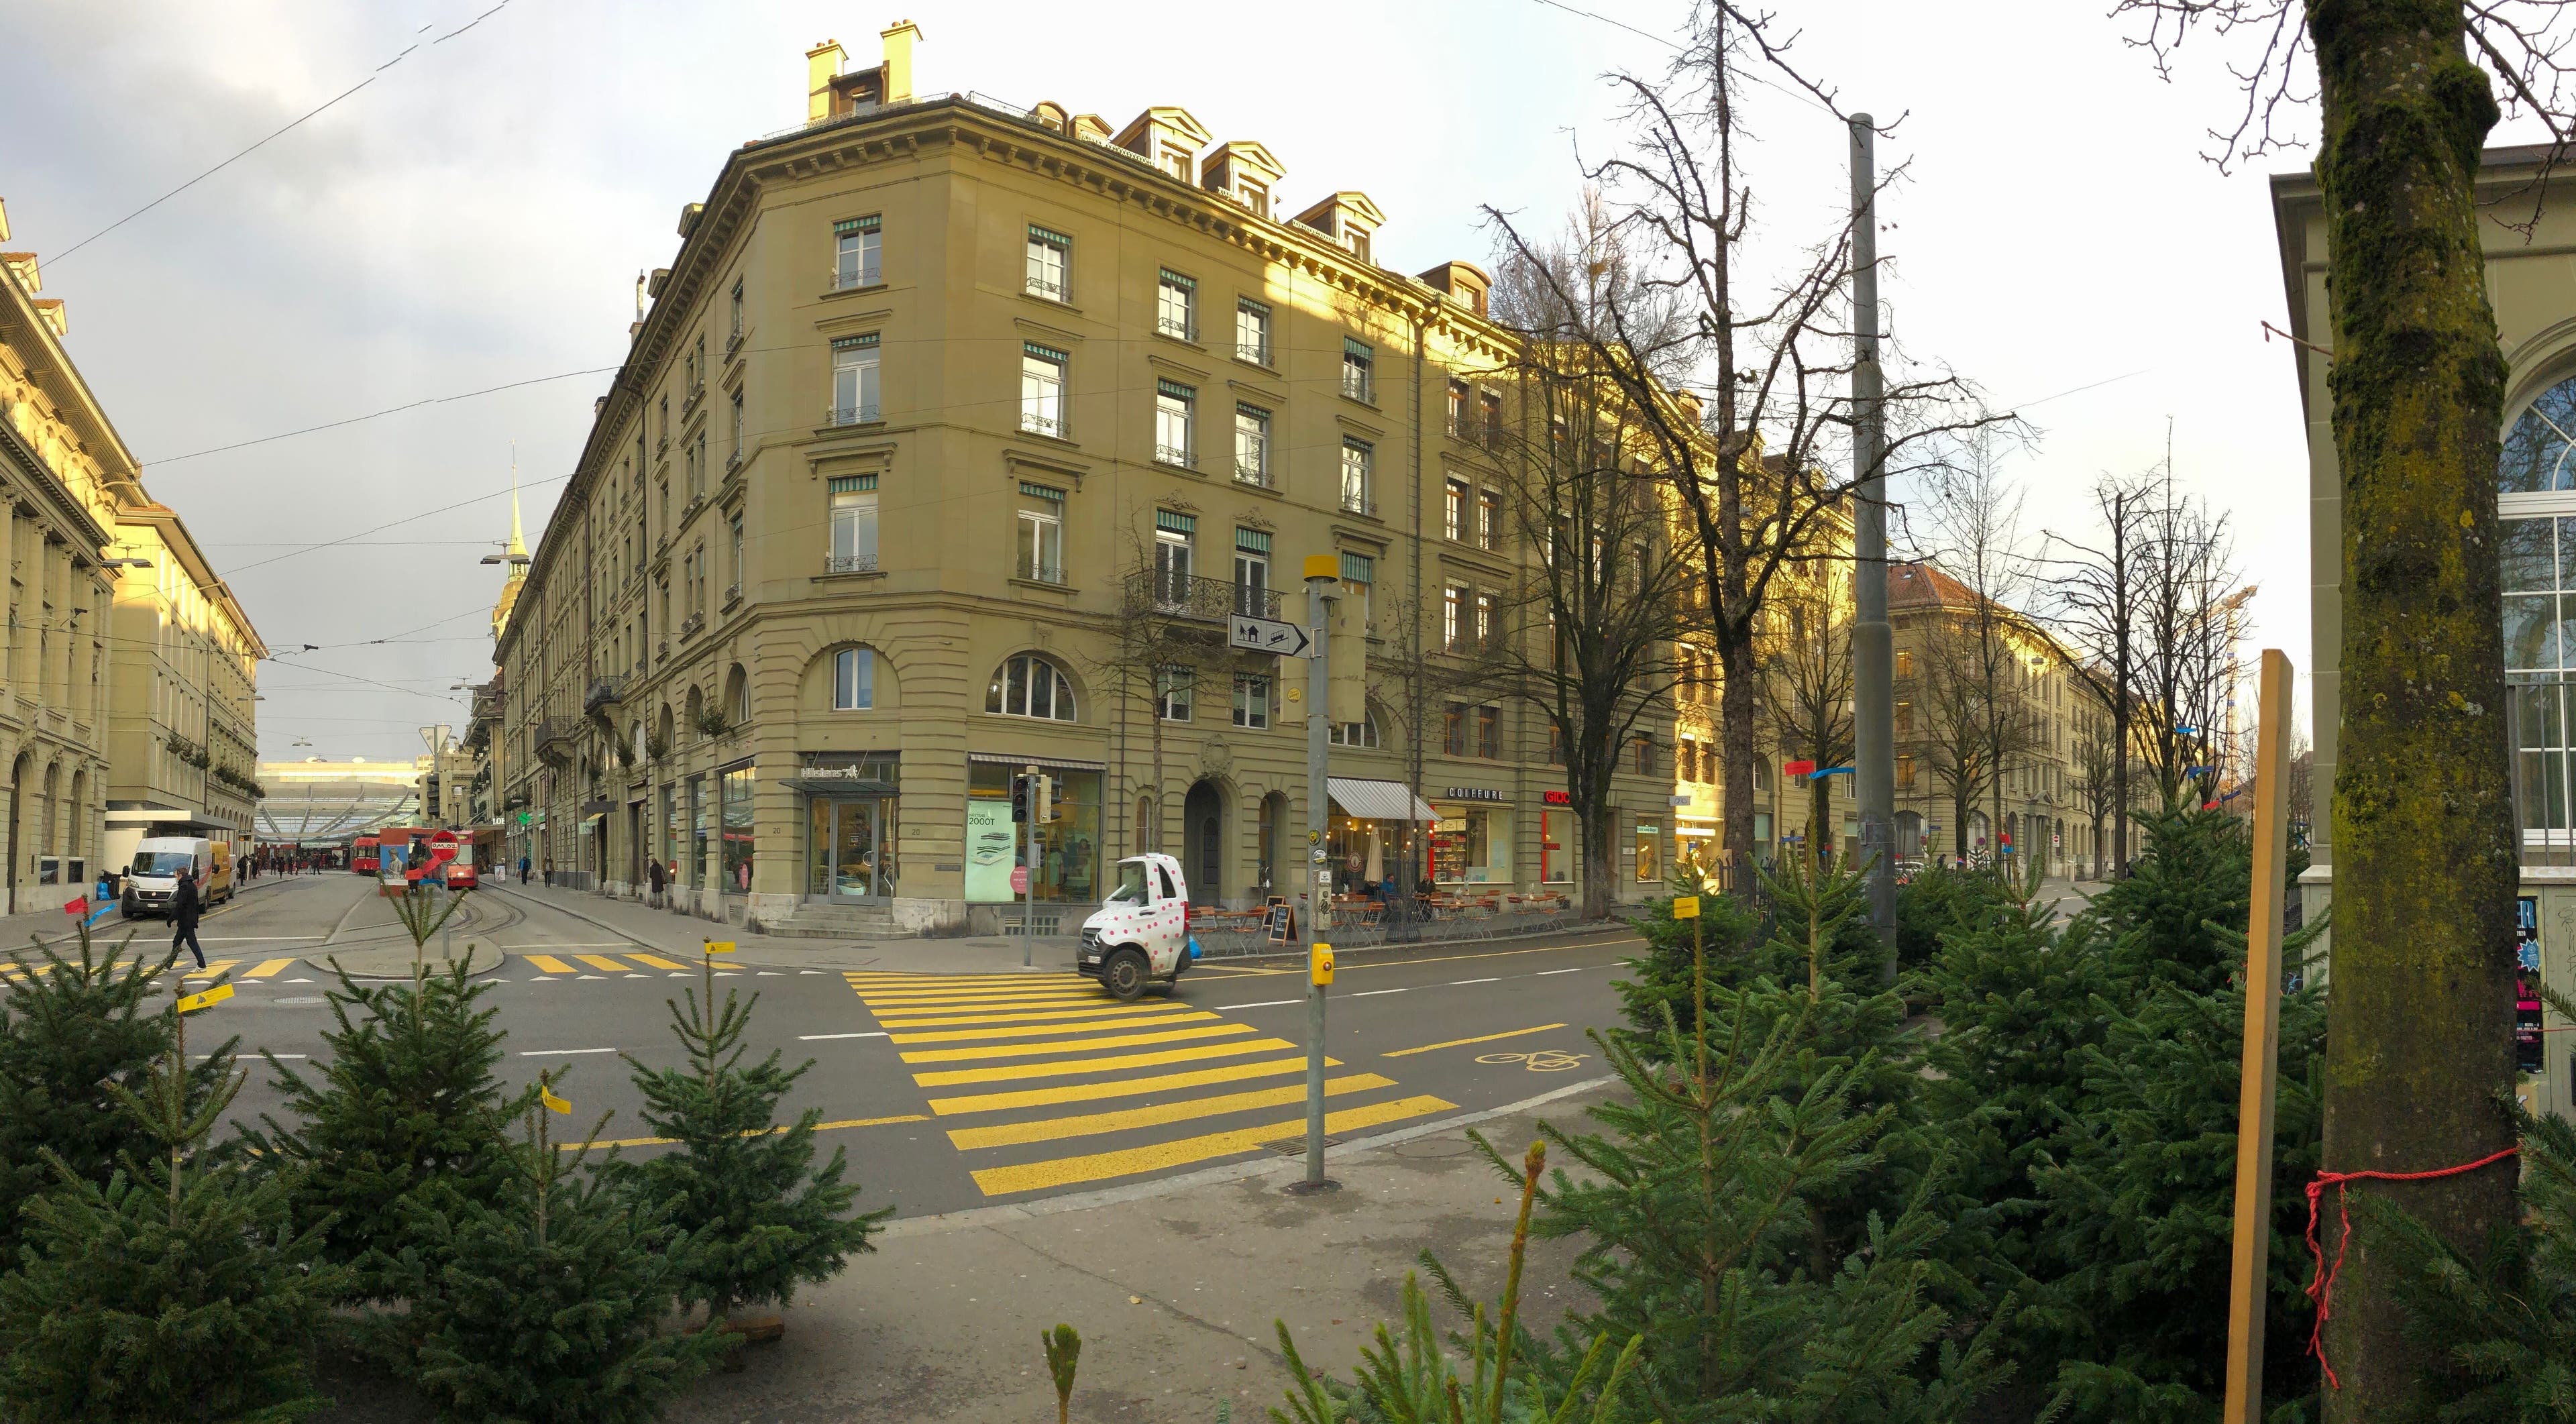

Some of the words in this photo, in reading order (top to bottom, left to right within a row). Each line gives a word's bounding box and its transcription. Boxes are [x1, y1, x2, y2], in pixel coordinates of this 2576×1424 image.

[1449, 787, 1503, 800] COIFFURE
[1546, 791, 1570, 804] GIDO
[969, 818, 995, 826] 2000T
